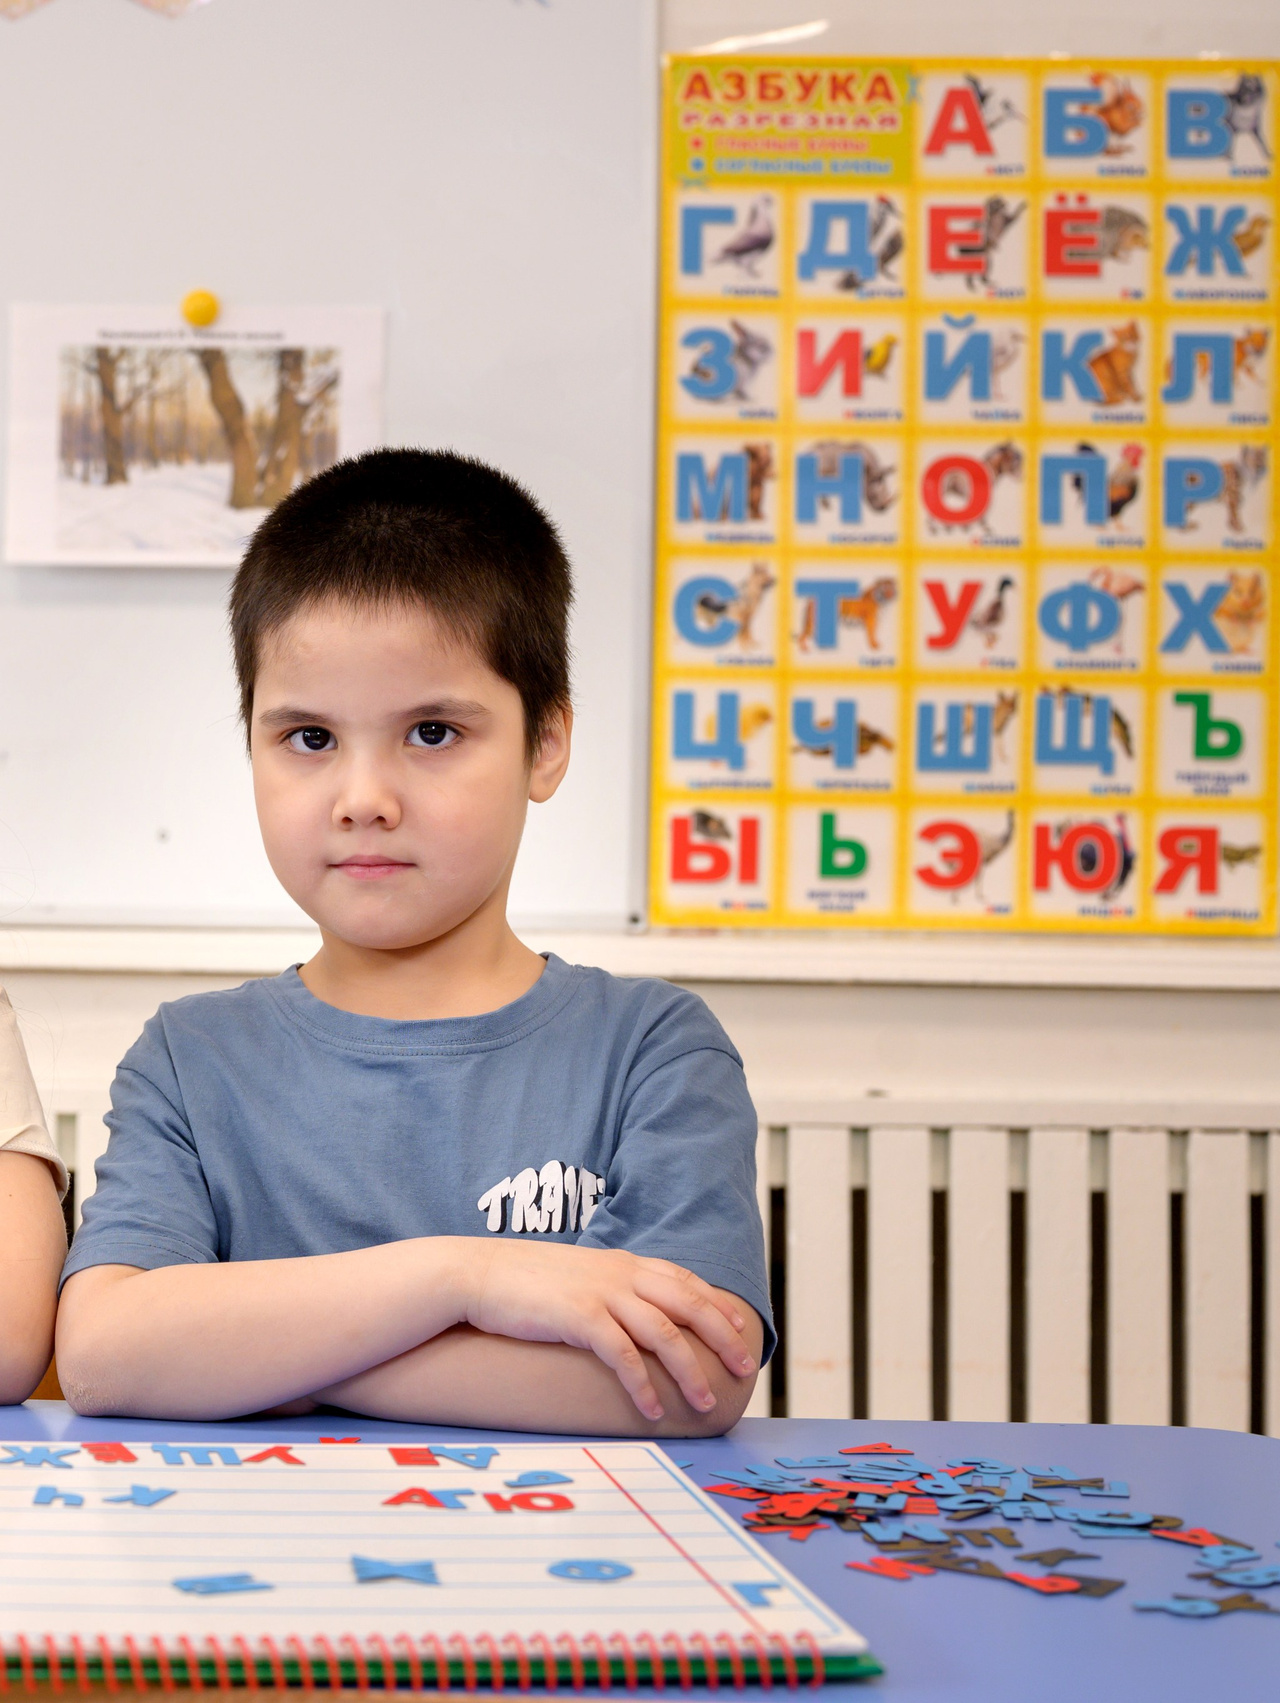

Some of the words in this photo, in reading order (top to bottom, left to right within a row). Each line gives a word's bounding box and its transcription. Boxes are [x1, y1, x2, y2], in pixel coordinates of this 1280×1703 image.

[683, 72, 896, 104] АЗБУКА
[923, 88, 994, 156] А
[1044, 88, 1109, 158] Б
[1166, 89, 1233, 159] В
[681, 206, 735, 275] Г
[797, 201, 878, 281] Д
[928, 205, 986, 274] Е
[1044, 194, 1101, 277] Ё
[1164, 206, 1247, 276] Ж
[680, 328, 738, 399] З
[797, 330, 862, 397] И
[923, 314, 992, 400] Й
[1042, 331, 1108, 400] К
[1161, 334, 1235, 403] Л
[676, 453, 749, 522] М
[796, 454, 861, 523] Н
[921, 455, 993, 525] О
[1041, 456, 1107, 525] П
[1163, 456, 1225, 528] Р
[673, 576, 741, 647] С
[795, 580, 860, 649] Т
[924, 581, 984, 650] У
[1038, 582, 1120, 652] Ф
[1160, 582, 1232, 653] Х
[672, 692, 745, 771] Ц
[792, 699, 857, 769] Ч
[916, 703, 993, 772] Ш
[1034, 693, 1115, 775] Щ
[1174, 692, 1243, 760] Ъ
[671, 817, 759, 884] Ы
[820, 812, 868, 879] Ь
[915, 821, 983, 889] Э
[1032, 824, 1123, 893] Ю
[1154, 827, 1219, 894] Я
[477, 1159, 607, 1234] TRAVE
